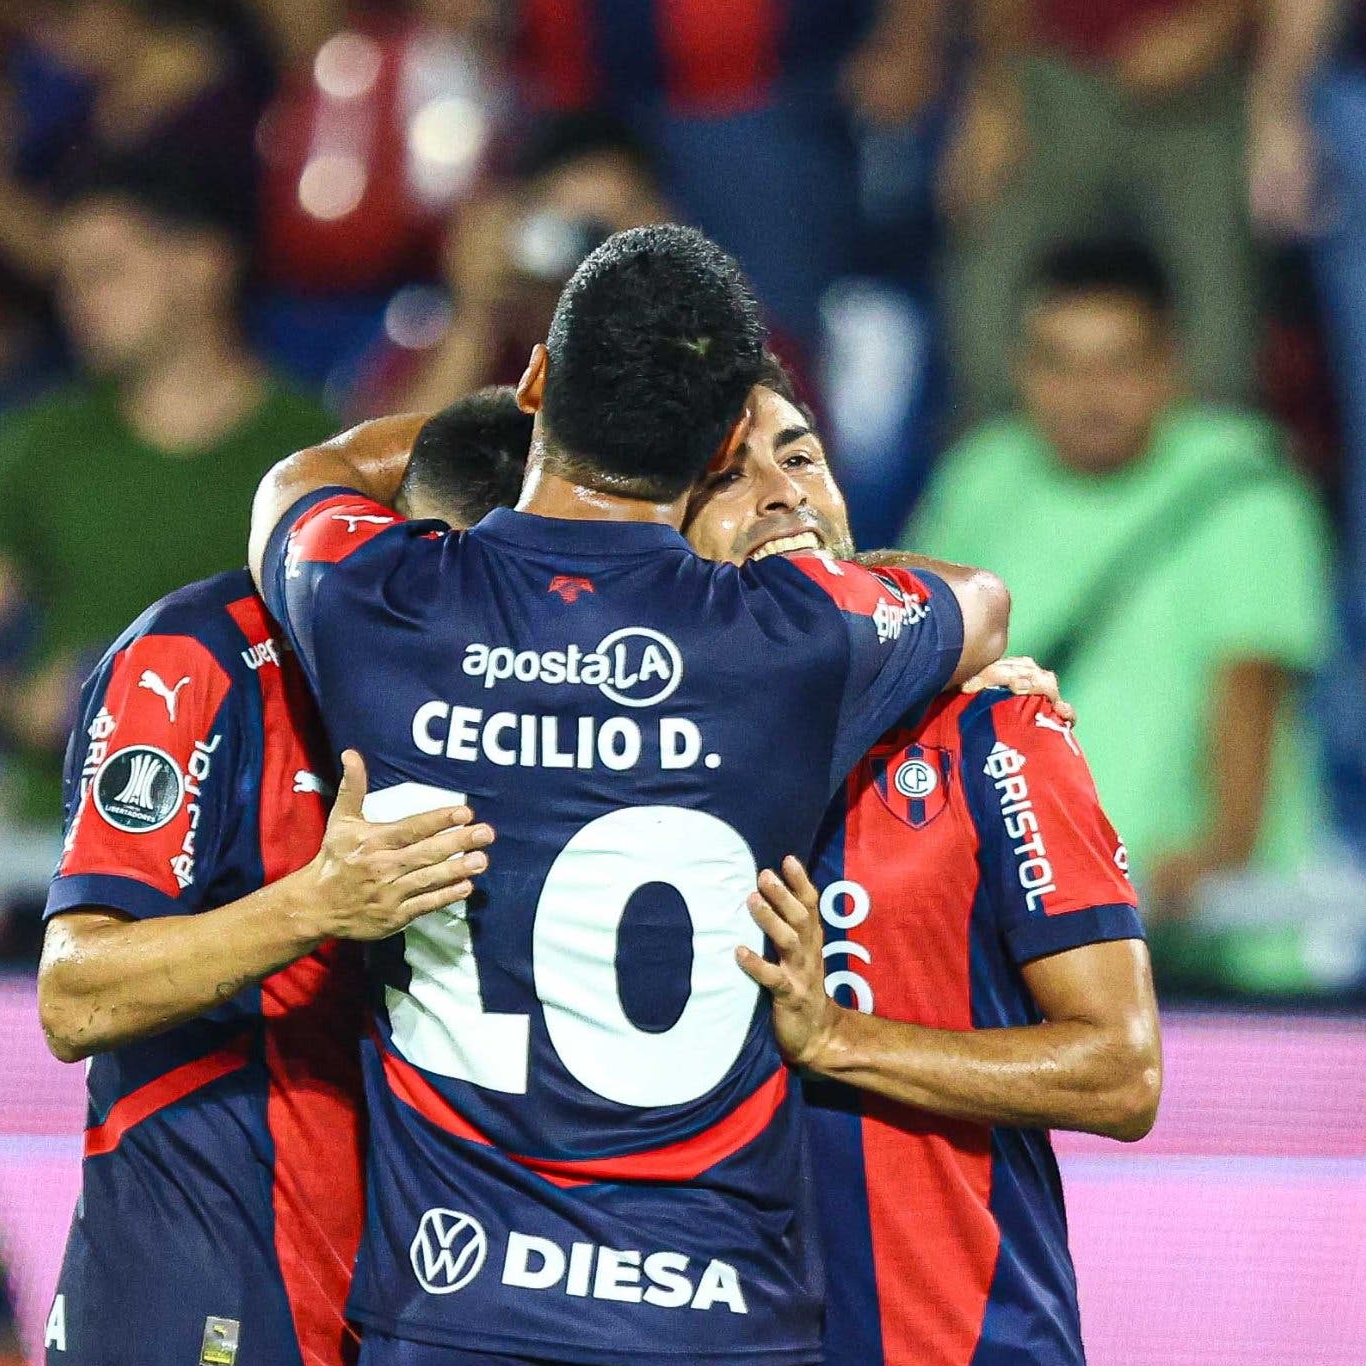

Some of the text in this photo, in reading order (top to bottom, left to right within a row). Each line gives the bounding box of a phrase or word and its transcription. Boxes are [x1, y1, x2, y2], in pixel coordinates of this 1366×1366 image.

[412, 701, 722, 771] CECILIO D.
[983, 742, 1057, 912] BRISTOL
[363, 782, 765, 1108] 10
[501, 1231, 749, 1315] DIESA
